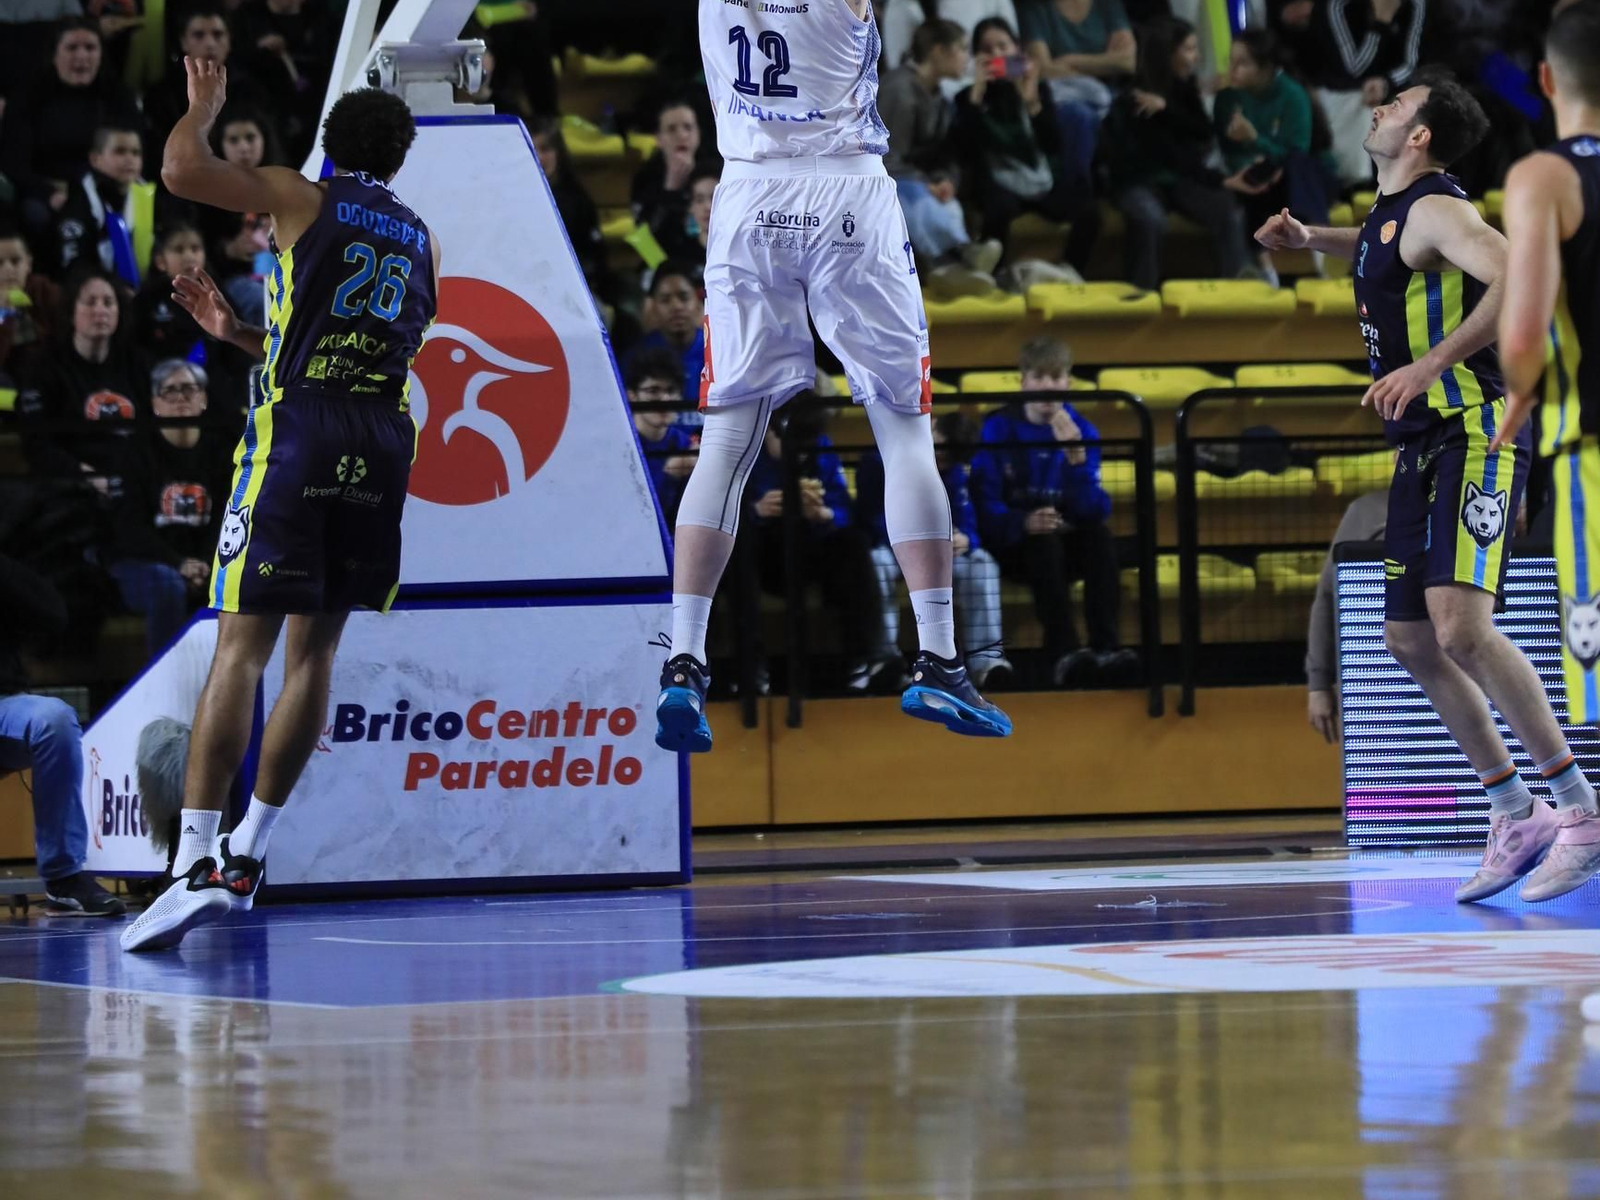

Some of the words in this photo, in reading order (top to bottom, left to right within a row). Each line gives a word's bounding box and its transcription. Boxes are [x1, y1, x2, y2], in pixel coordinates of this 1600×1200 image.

[728, 25, 798, 98] 12
[755, 210, 764, 223] A
[769, 211, 820, 227] Coruña
[331, 242, 412, 322] 26
[332, 699, 638, 743] BricoCentro
[404, 744, 643, 792] Paradelo
